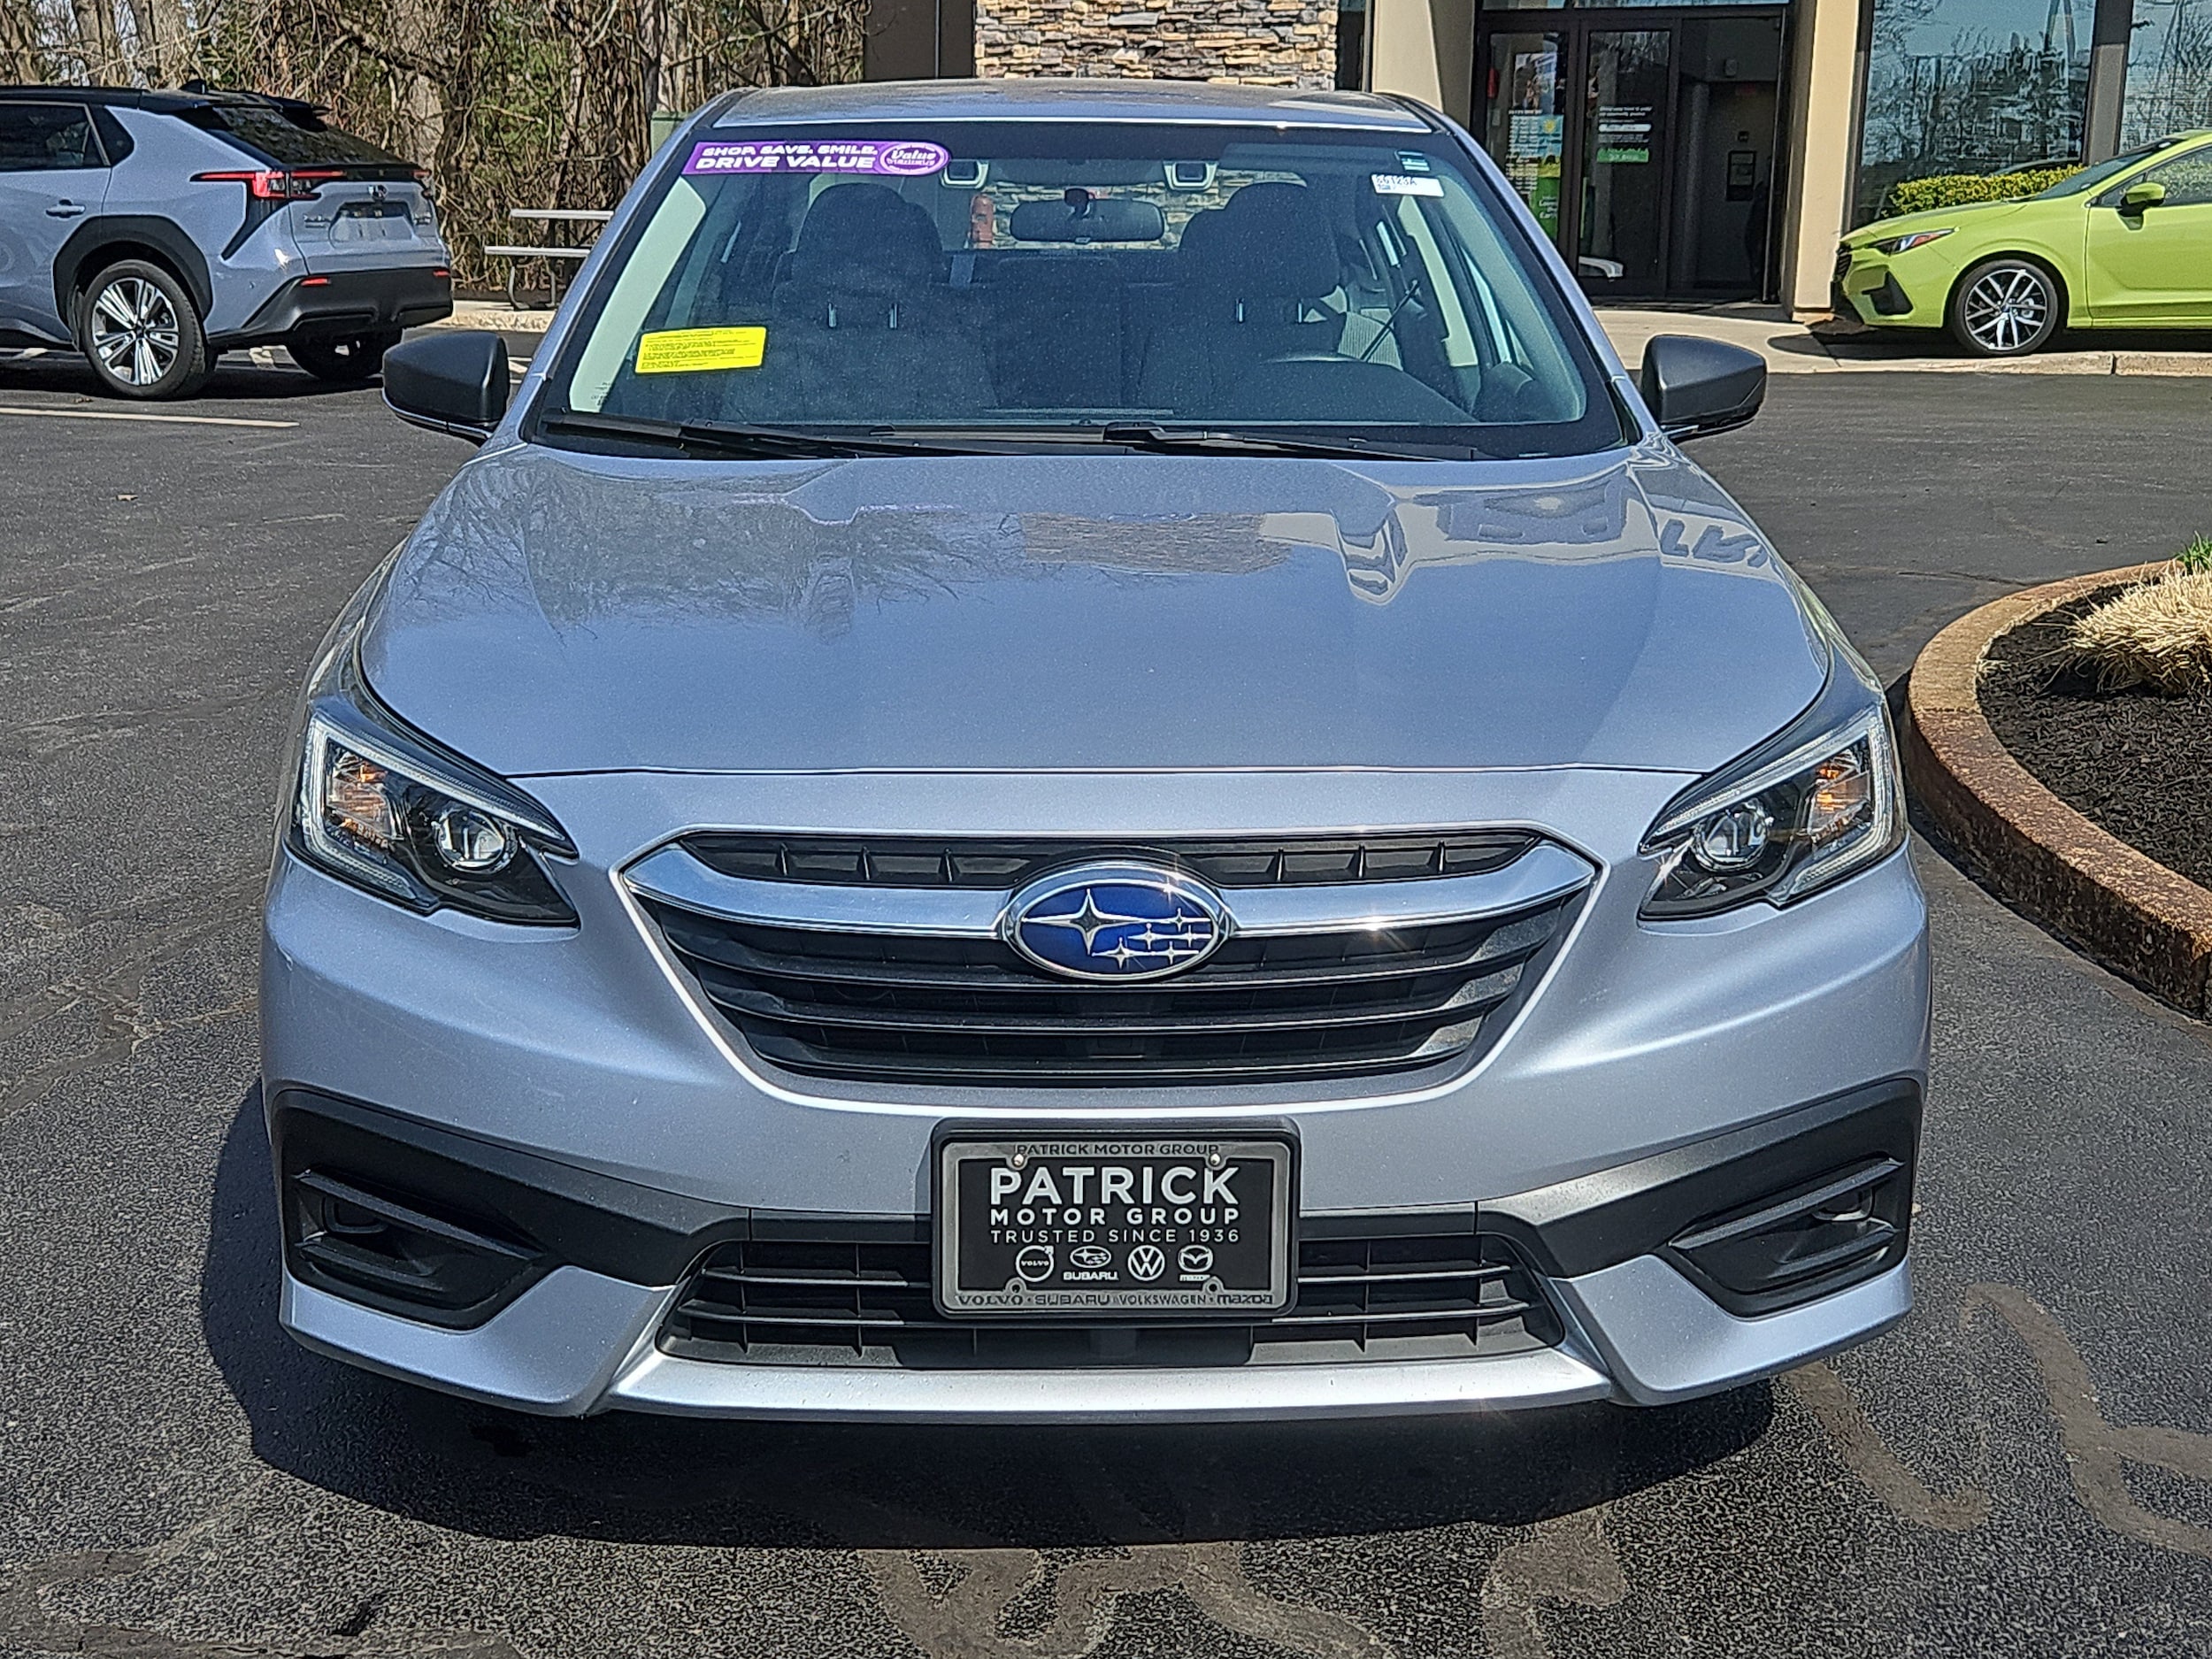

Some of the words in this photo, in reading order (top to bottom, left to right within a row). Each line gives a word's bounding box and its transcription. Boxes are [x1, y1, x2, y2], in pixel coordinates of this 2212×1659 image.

[760, 144, 813, 155] SAVE.
[818, 144, 879, 155] SMILE.
[891, 149, 937, 160] Value
[695, 156, 780, 169] DRIVE
[787, 156, 876, 168] VALUE
[1016, 1144, 1089, 1156] PATRICK
[1094, 1144, 1155, 1156] MOTOR
[1160, 1144, 1219, 1156] GROUP
[990, 1166, 1239, 1205] PATRICK
[990, 1208, 1106, 1226] MOTOR
[1126, 1207, 1239, 1225] GROUP
[990, 1229, 1095, 1244] TRUSTED
[1108, 1229, 1177, 1243] SINCE
[1189, 1229, 1239, 1243] 1936
[1063, 1271, 1119, 1281] SUBARU
[958, 1294, 1024, 1306] VOLVO
[1034, 1294, 1110, 1306] SUBARU
[1118, 1294, 1206, 1306] VOLKSWAGEN
